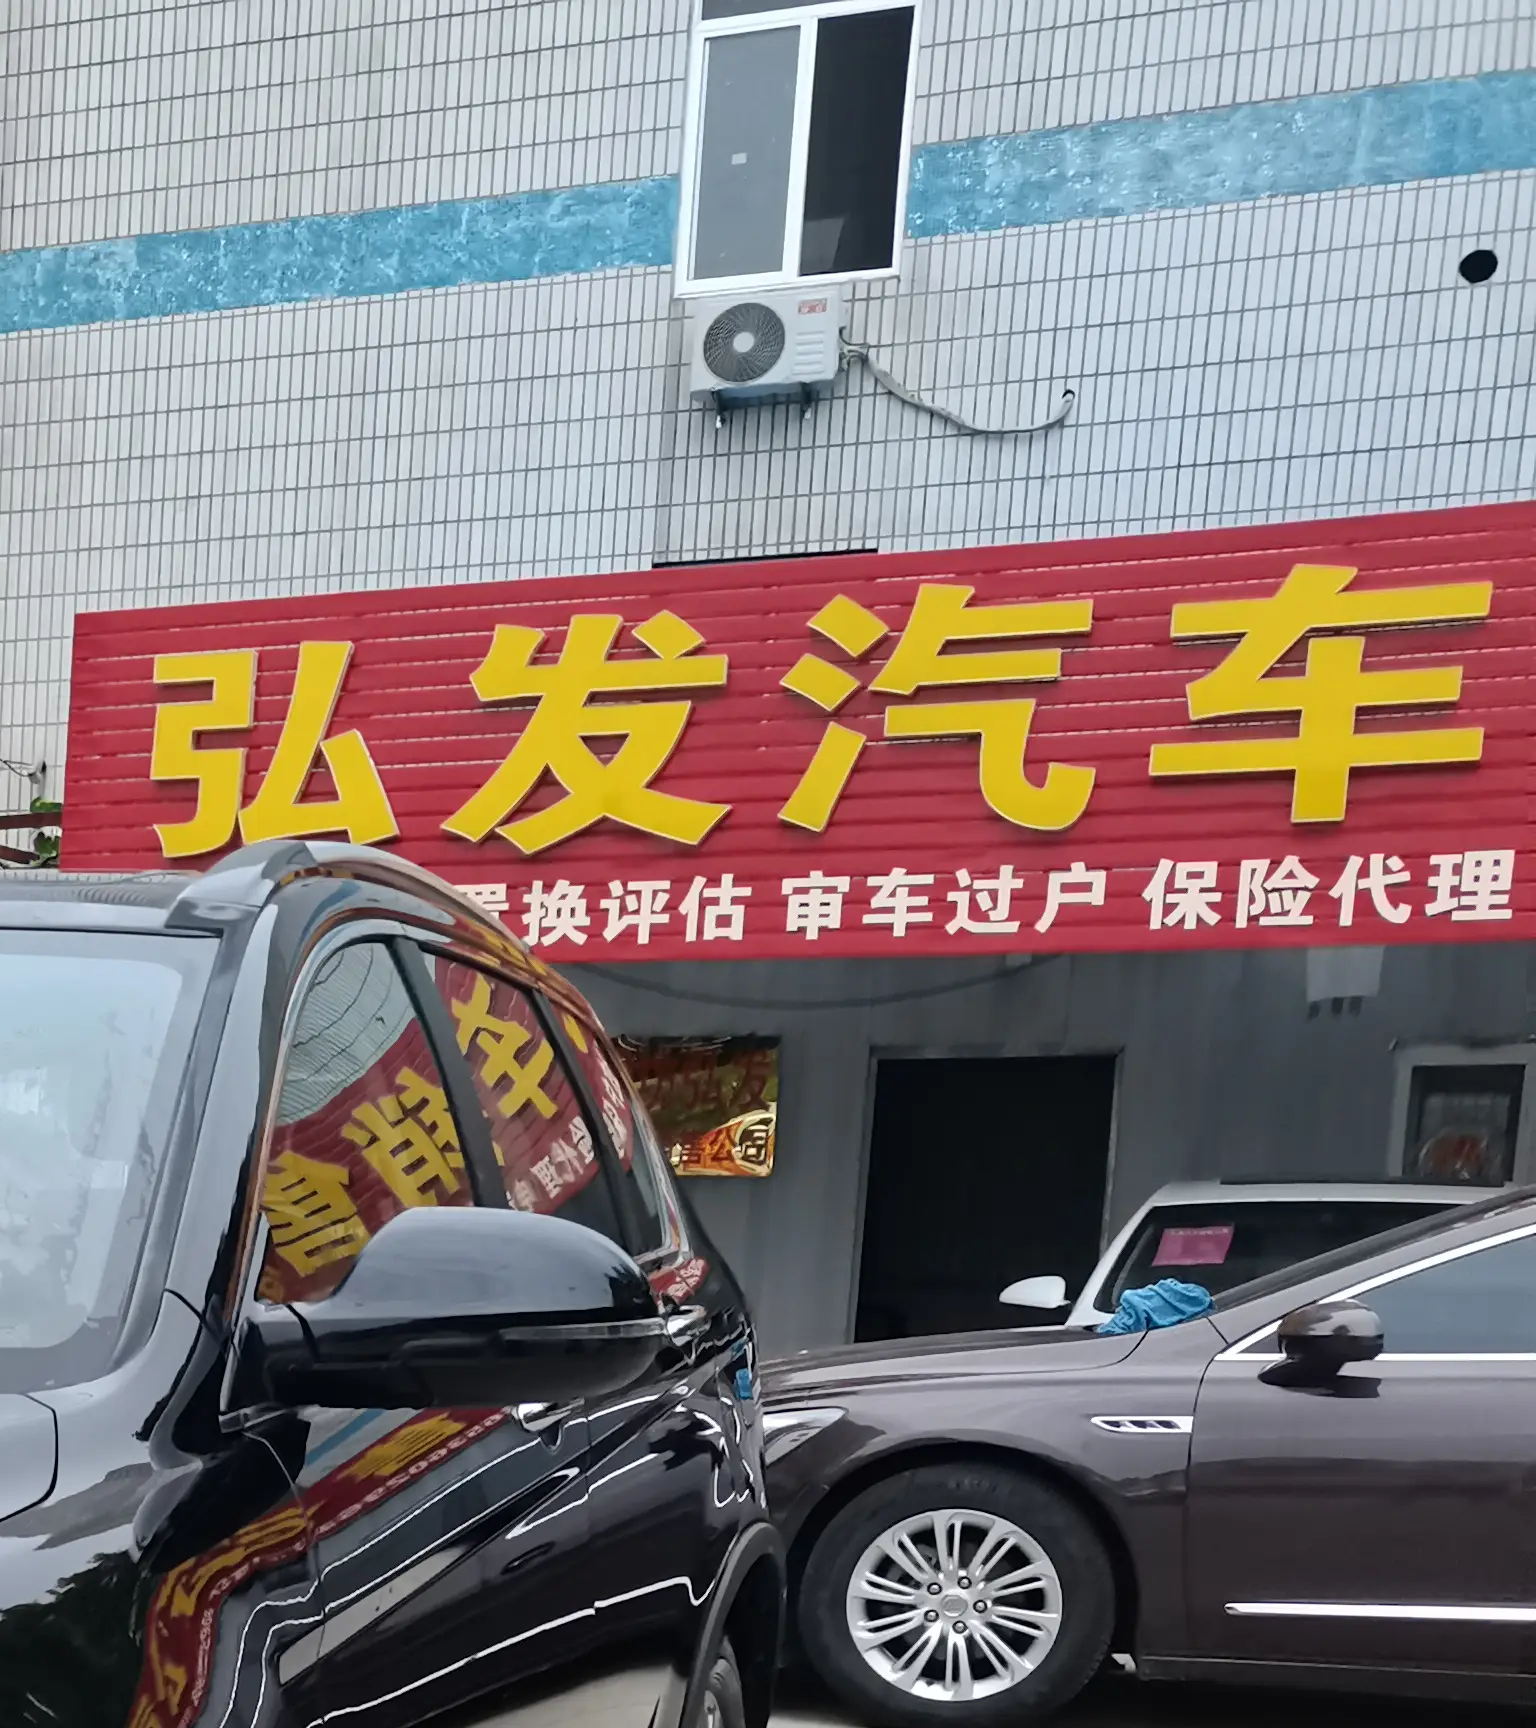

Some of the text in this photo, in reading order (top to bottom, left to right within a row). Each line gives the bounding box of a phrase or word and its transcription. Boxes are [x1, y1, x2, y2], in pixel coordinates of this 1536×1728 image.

[151, 561, 1494, 858] 弘发汽车
[780, 861, 1109, 941] 审车过户
[1141, 849, 1517, 932] 保险代理
